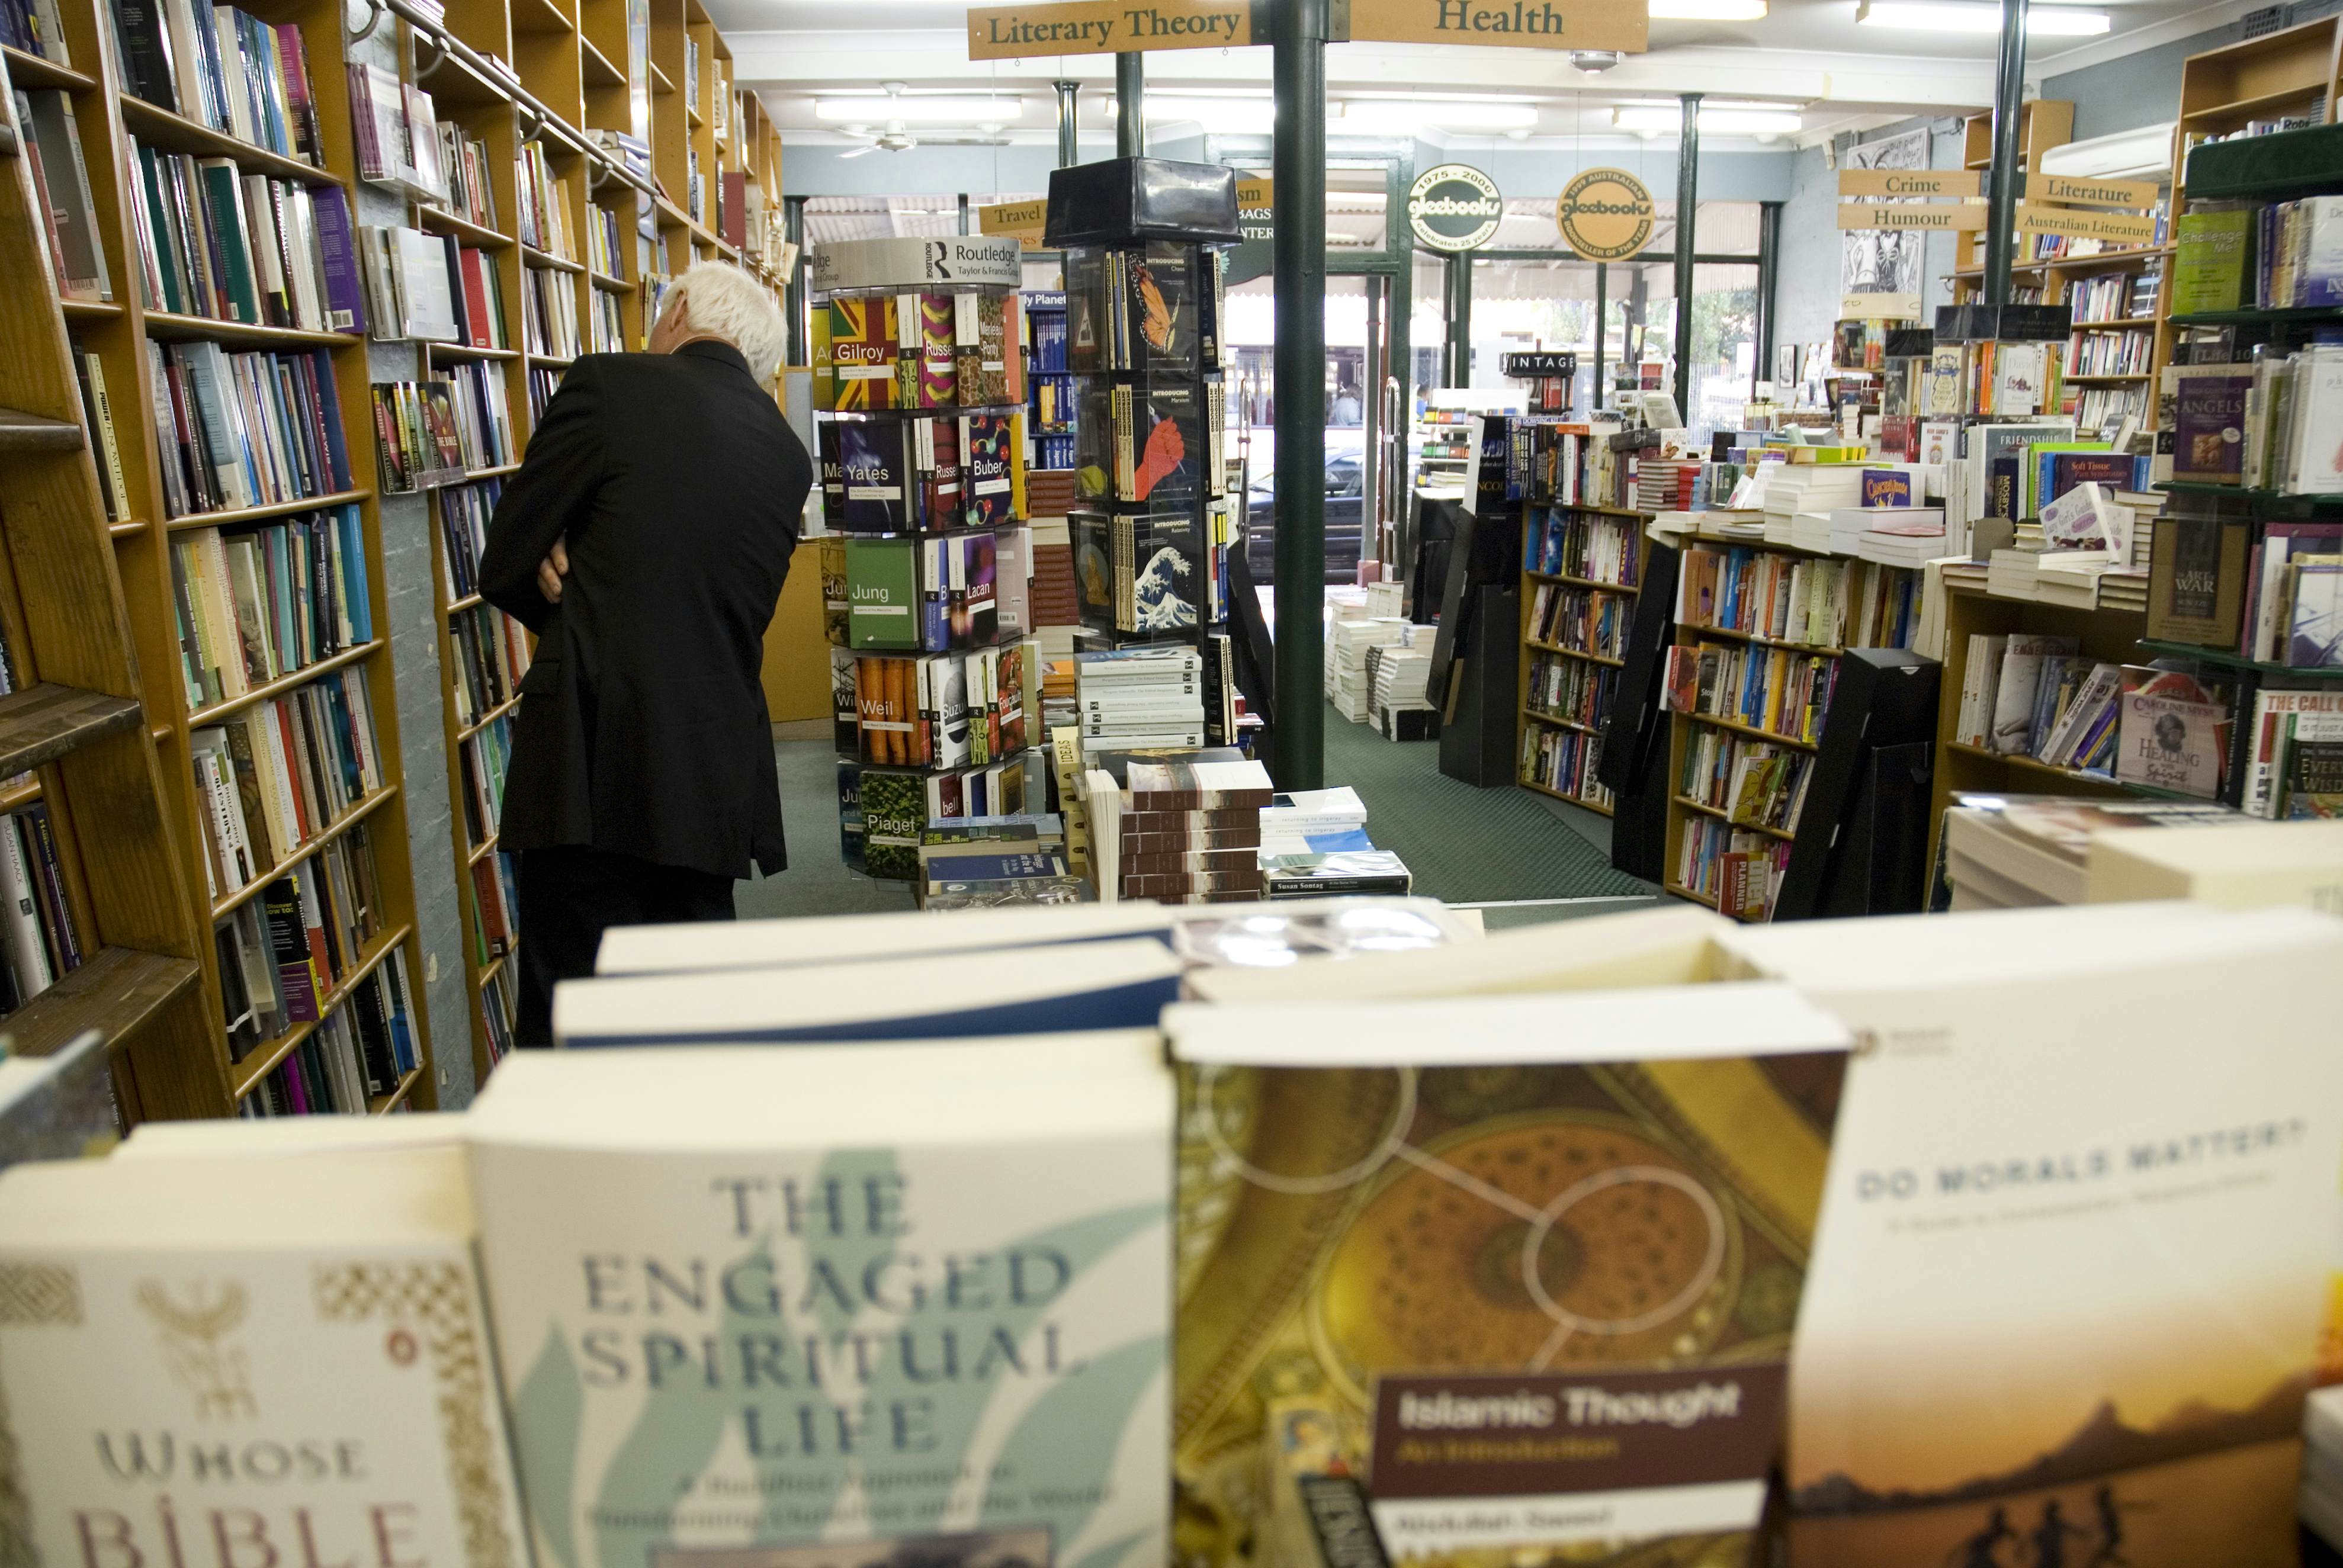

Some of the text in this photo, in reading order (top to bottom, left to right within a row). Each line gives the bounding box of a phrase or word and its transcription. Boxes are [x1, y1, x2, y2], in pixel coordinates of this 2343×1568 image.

[1434, 0, 1564, 34] Health
[987, 8, 1241, 47] Literary Theory
[1904, 134, 1922, 147] part
[1892, 149, 1919, 162] in your
[76, 142, 94, 210] POSTMODERNISM
[1418, 170, 1449, 191] 1975
[1463, 171, 1493, 194] 2000
[1570, 171, 1644, 200] 1999 AUSTRALIAN
[1886, 176, 1941, 192] Crime
[2047, 179, 2132, 203] Literature
[994, 205, 1041, 224] Travel
[1408, 196, 1501, 220] gleebooks
[1561, 200, 1651, 219] gleebooks
[1873, 209, 1952, 226] Humour
[1416, 223, 1458, 247] celebrates
[1472, 223, 1493, 246] years
[2024, 214, 2152, 237] Australian Literature
[1564, 220, 1604, 256] BOOKSELLER
[1618, 242, 1635, 255] THE
[1632, 220, 1649, 248] YEAR
[2181, 229, 2243, 245] Challenge
[925, 242, 933, 279] ROUTLEDGE
[956, 245, 1015, 266] Routledge
[822, 272, 839, 282] Group
[957, 266, 981, 277] Taylor
[988, 267, 1008, 275] Francis
[1035, 294, 1066, 305] Planet
[980, 321, 1003, 336] Merleau
[837, 343, 884, 362] Gilroy
[980, 343, 999, 358] -Ponty
[2201, 348, 2229, 361] Life
[2181, 400, 2242, 414] ANGELS
[320, 422, 332, 465] LEWIS
[436, 435, 458, 446] THE BIBLE
[2000, 435, 2059, 445] FRIENDSHIP
[846, 465, 889, 481] Yates
[973, 460, 1003, 476] Buber
[2071, 461, 2111, 470] Soft Tissue
[405, 471, 413, 490] MONK
[1154, 519, 1190, 528] INTRODUCING
[2043, 522, 2059, 535] Lazy
[2187, 570, 2209, 582] ART
[852, 584, 889, 603] Jung
[967, 583, 990, 599] Lacan
[2175, 579, 2214, 593] WAR
[185, 583, 193, 612] Theories
[861, 701, 893, 716] Weil
[998, 689, 1022, 711] Foucault
[2133, 698, 2182, 713] CAROLINE
[2267, 695, 2332, 711] THE CALL
[1060, 740, 1070, 763] IDEAS
[2139, 738, 2200, 767] HEALING
[214, 777, 232, 840] QUESTIONS
[224, 786, 242, 844] PHILOSOPHY
[943, 796, 958, 815] bell
[868, 814, 916, 834] Piaget
[38, 818, 53, 864] HABERMAS
[3, 824, 23, 885] SUSAN HAACK
[1299, 882, 1324, 891] Sontag
[1735, 861, 1747, 911] PLANNER
[297, 900, 311, 952] Philosophy
[374, 985, 385, 1023] NIETZSCHE
[1856, 1169, 1918, 1203] DO
[1937, 1148, 2111, 1199] MORALS
[2126, 1117, 2307, 1173] MATTER?
[711, 1171, 913, 1239] THE
[578, 1245, 1073, 1318] ENGAGED
[579, 1322, 1088, 1390] SPIRITUAL
[1398, 1377, 1744, 1432] Islamic Thought
[742, 1396, 941, 1458] LIFE
[1446, 1435, 1620, 1461] Introduction
